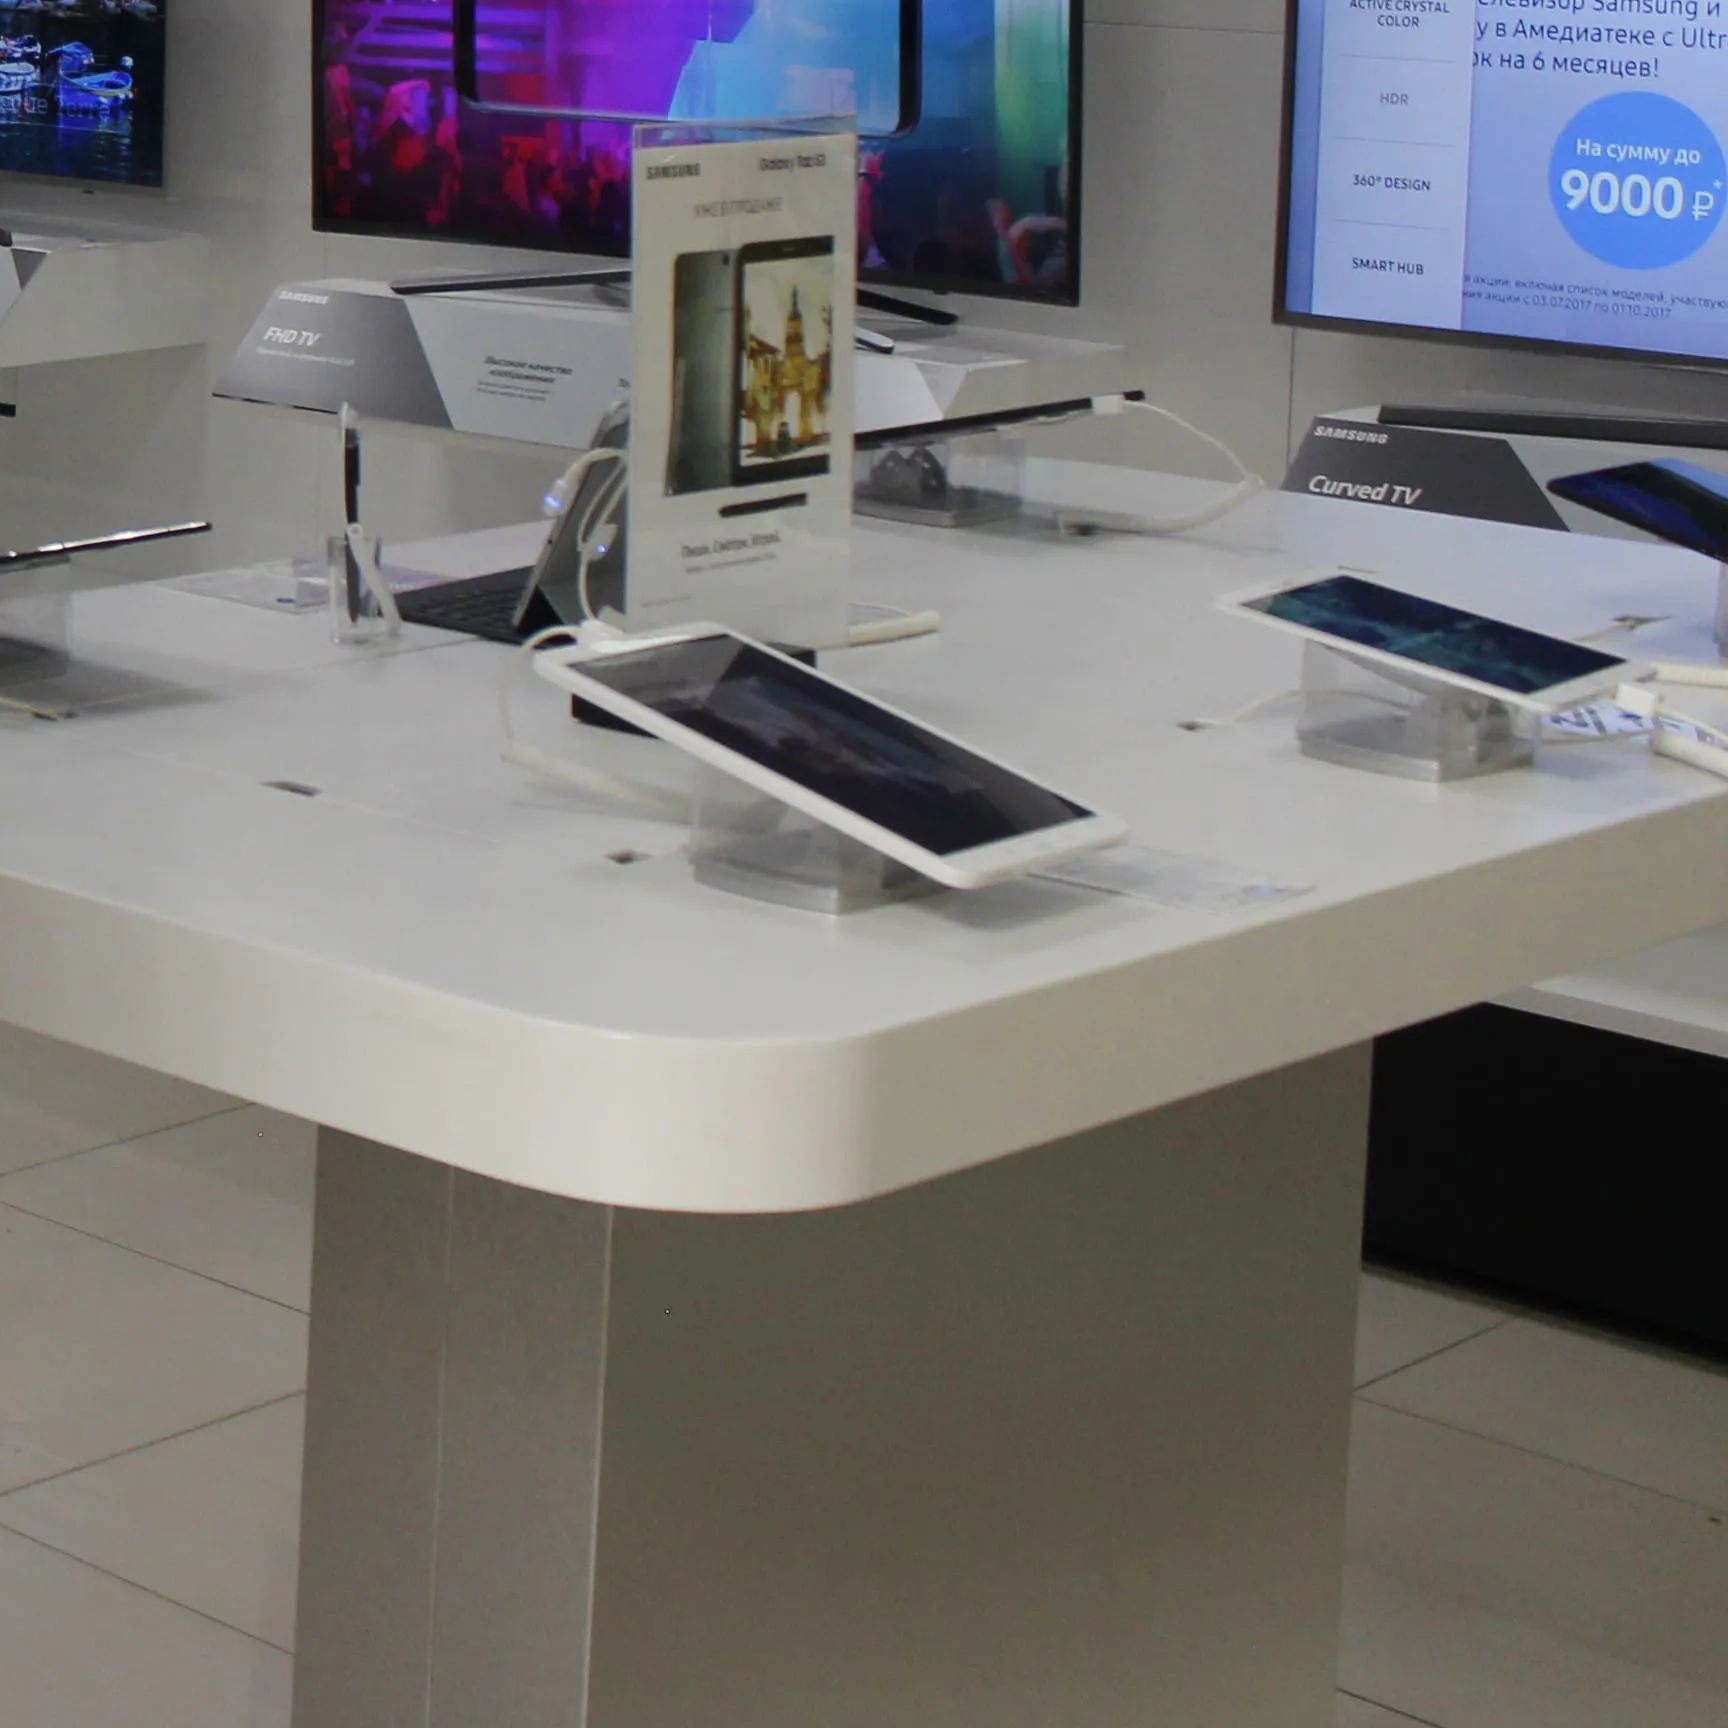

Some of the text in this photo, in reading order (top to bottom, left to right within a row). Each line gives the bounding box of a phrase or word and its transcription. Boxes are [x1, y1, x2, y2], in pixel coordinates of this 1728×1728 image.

[1706, 1, 1721, 17] и
[1376, 14, 1421, 29] COLOR
[1475, 18, 1728, 50] у в Амедиатеке с Ultr
[1499, 52, 1526, 70] на
[1531, 50, 1546, 72] 6
[1551, 54, 1660, 80] месяцев!
[1379, 91, 1409, 106] HDR
[1576, 137, 1702, 167] На сумму до
[645, 162, 702, 181] SAMSUNG
[1384, 176, 1432, 192] DESIGN
[1560, 168, 1684, 220] 9000
[1351, 257, 1425, 276] SMART HUB
[1593, 301, 1610, 313] по
[263, 325, 323, 347] FHD TV
[1313, 425, 1390, 445] SAMSUNG
[1308, 474, 1424, 506] Curved TV
